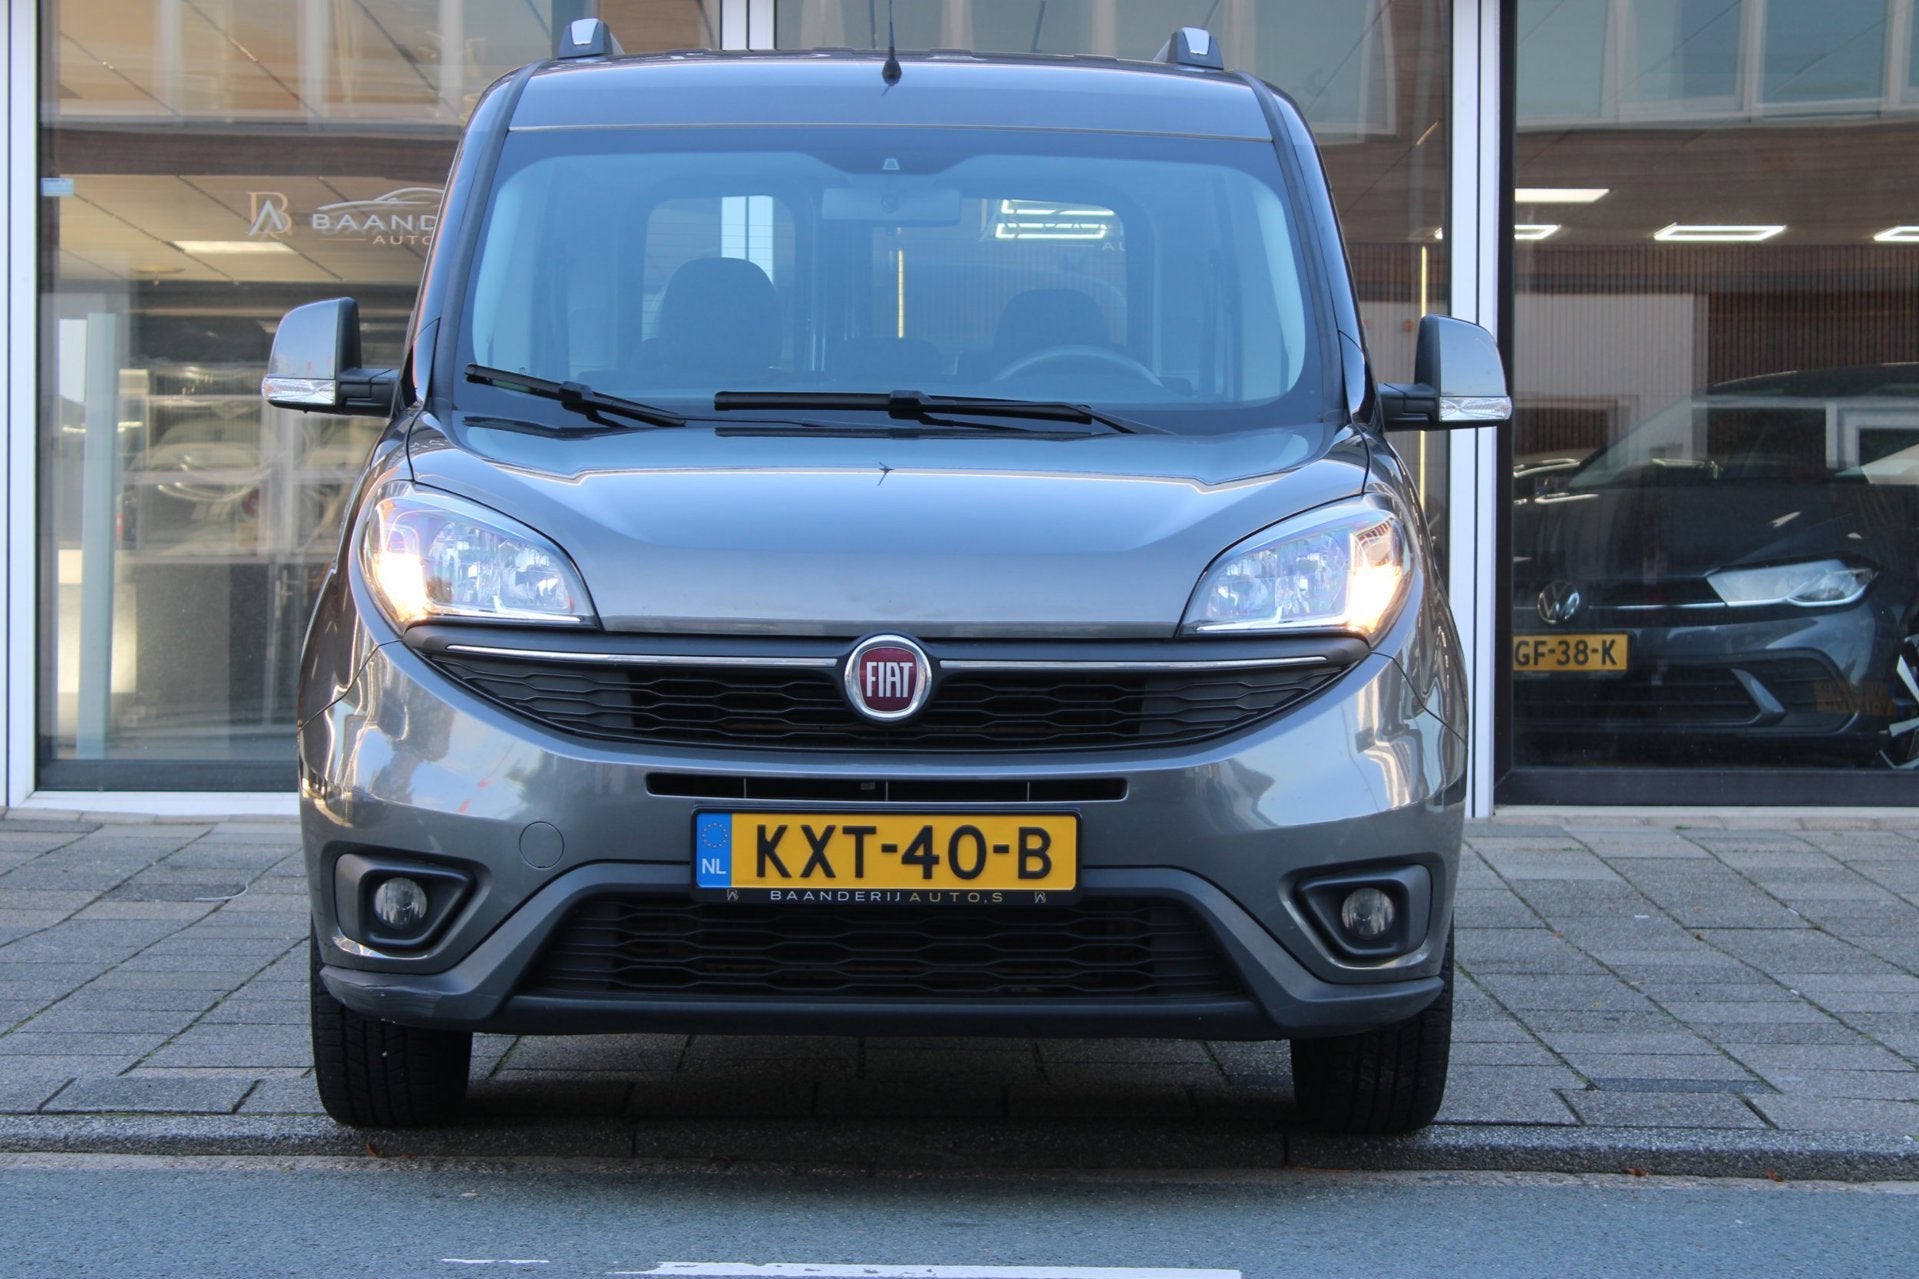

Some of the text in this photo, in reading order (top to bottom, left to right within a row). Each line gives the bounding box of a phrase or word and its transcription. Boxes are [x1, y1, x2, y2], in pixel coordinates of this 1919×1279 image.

[1514, 639, 1617, 666] GF-38-K
[866, 661, 914, 698] FIAT
[756, 824, 1053, 881] KXT-40-B
[702, 858, 727, 875] NL
[769, 890, 900, 902] BAANDERIJ
